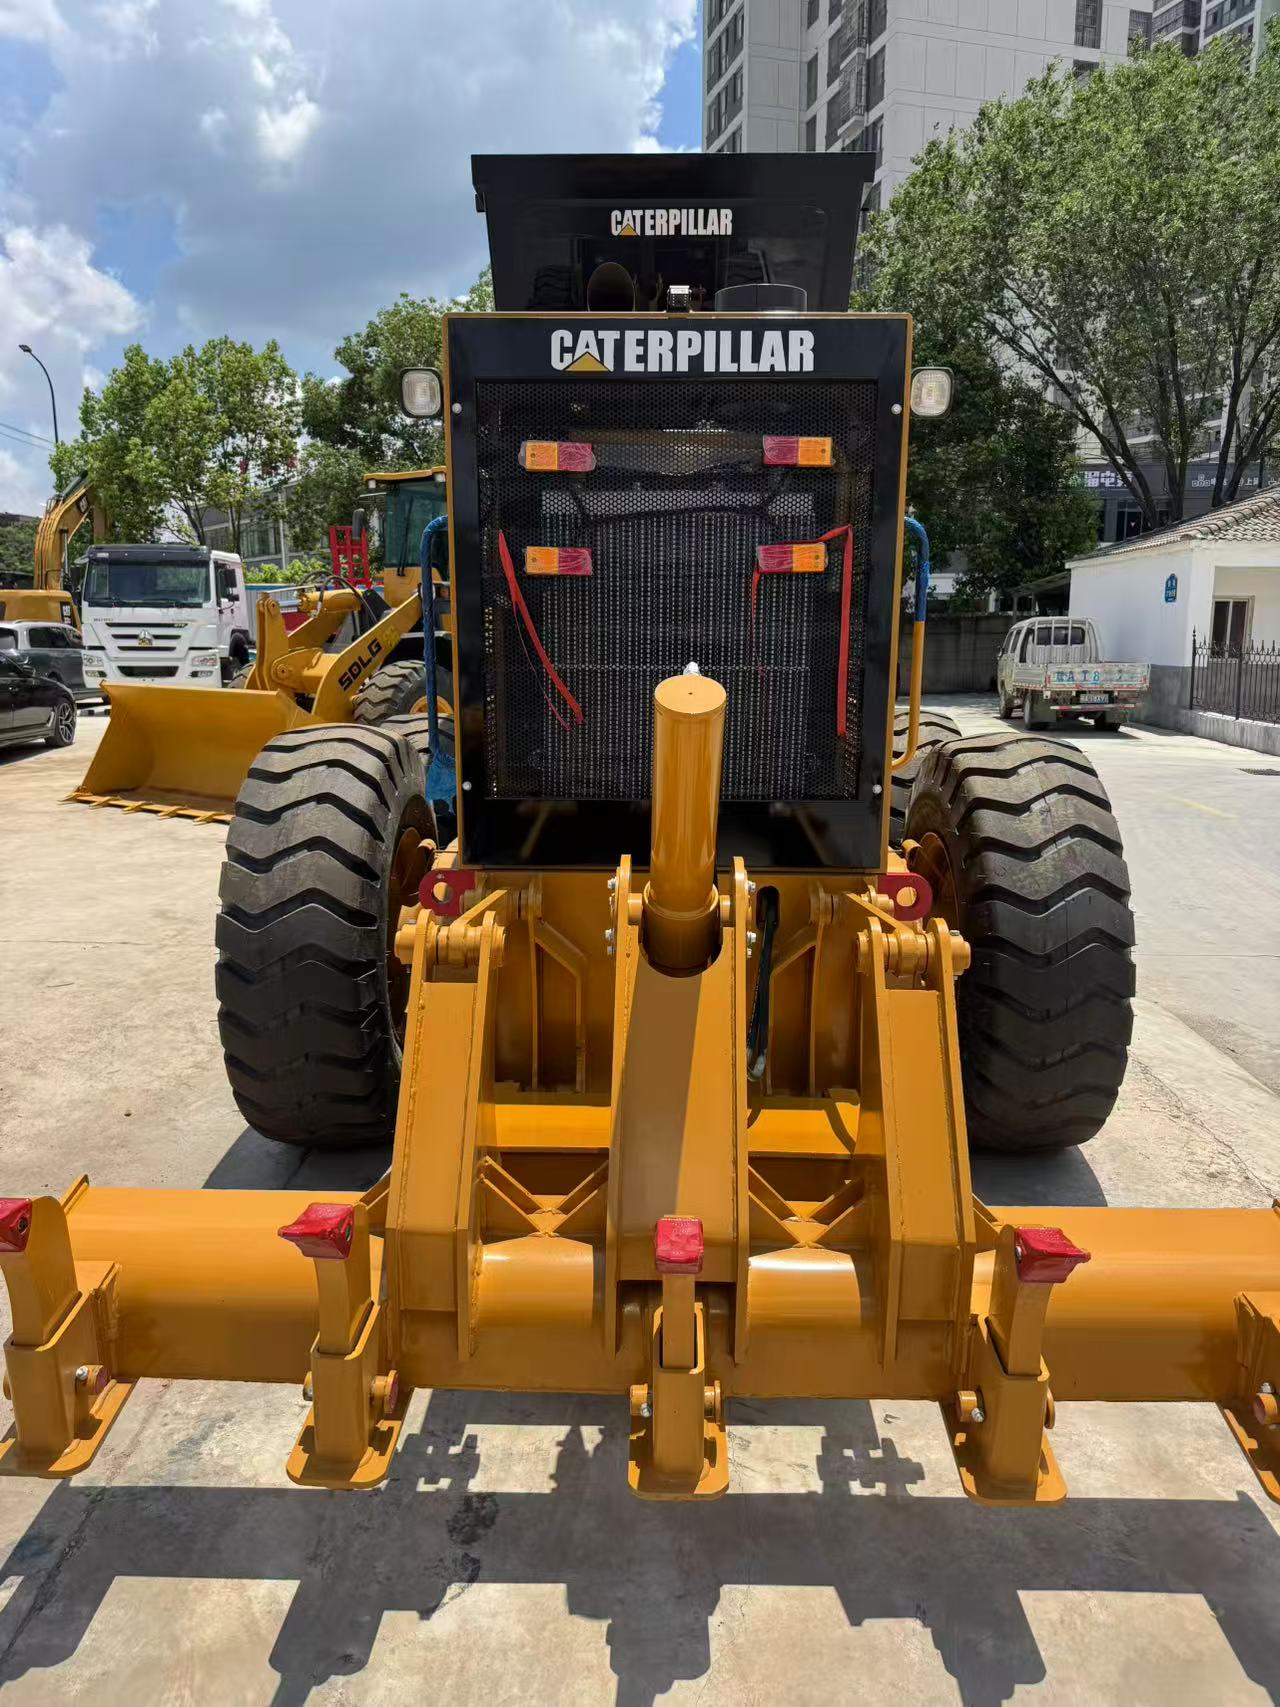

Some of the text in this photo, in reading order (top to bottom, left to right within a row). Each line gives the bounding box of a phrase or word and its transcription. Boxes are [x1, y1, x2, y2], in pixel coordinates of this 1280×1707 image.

[611, 208, 733, 236] CATERPILLAR
[551, 329, 815, 373] CATERPILLAR
[338, 637, 382, 692] SDLG
